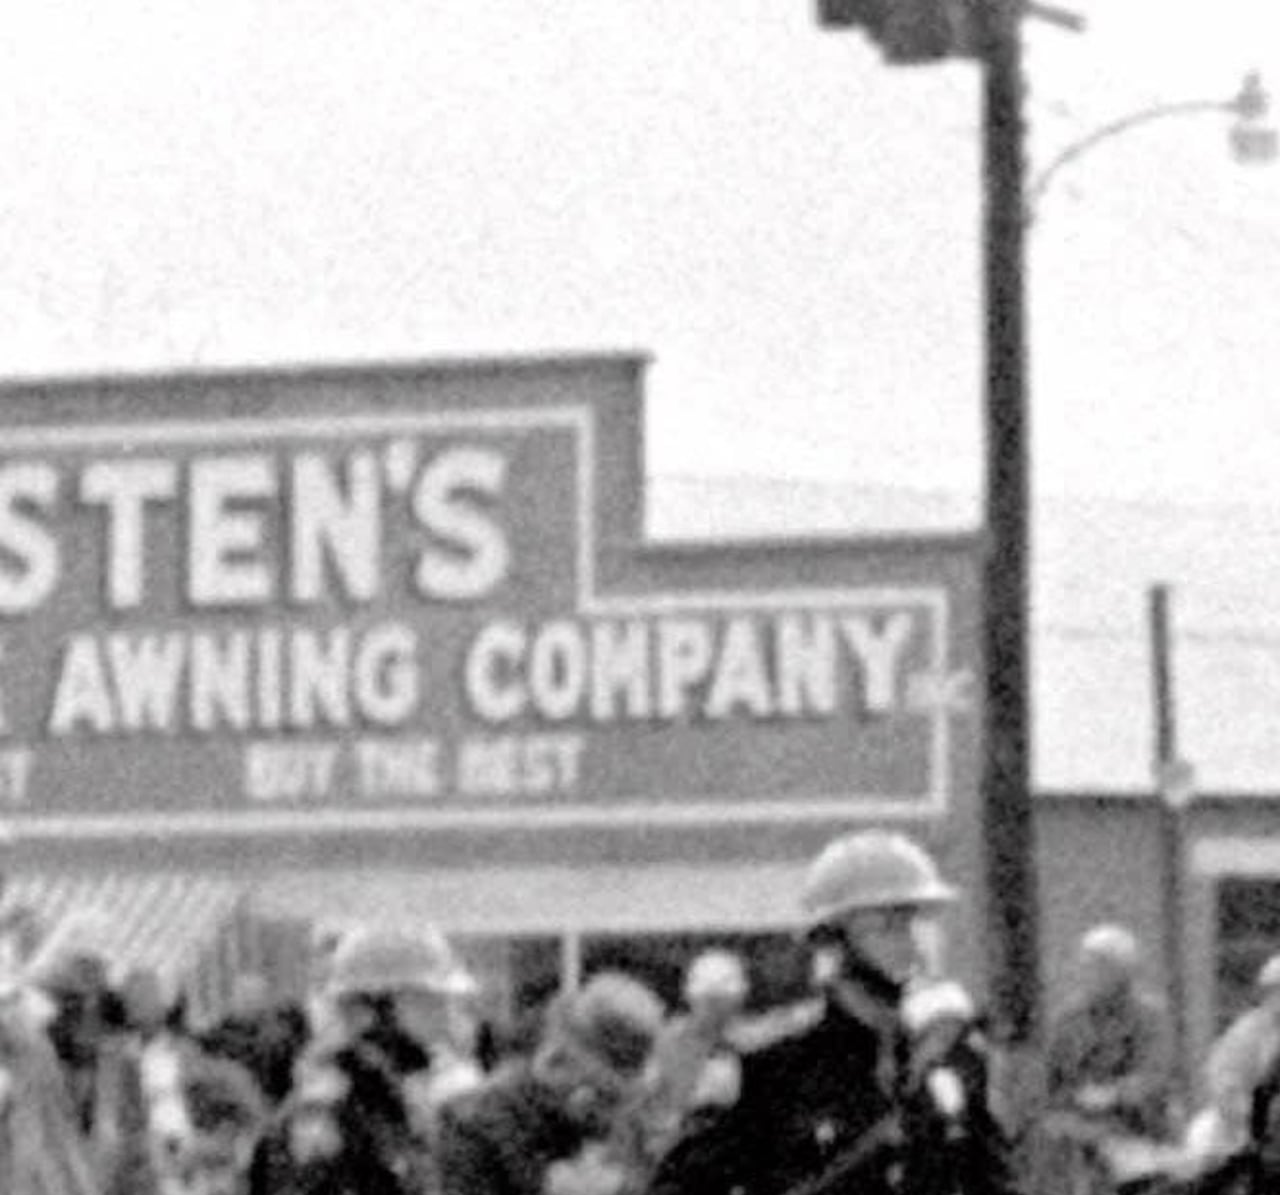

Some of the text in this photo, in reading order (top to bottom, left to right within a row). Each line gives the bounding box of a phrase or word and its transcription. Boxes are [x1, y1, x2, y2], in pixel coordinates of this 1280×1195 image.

[50, 625, 419, 736] AWNING
[466, 612, 912, 721] COMPANY
[247, 743, 336, 798] BUY
[353, 738, 441, 797] THE
